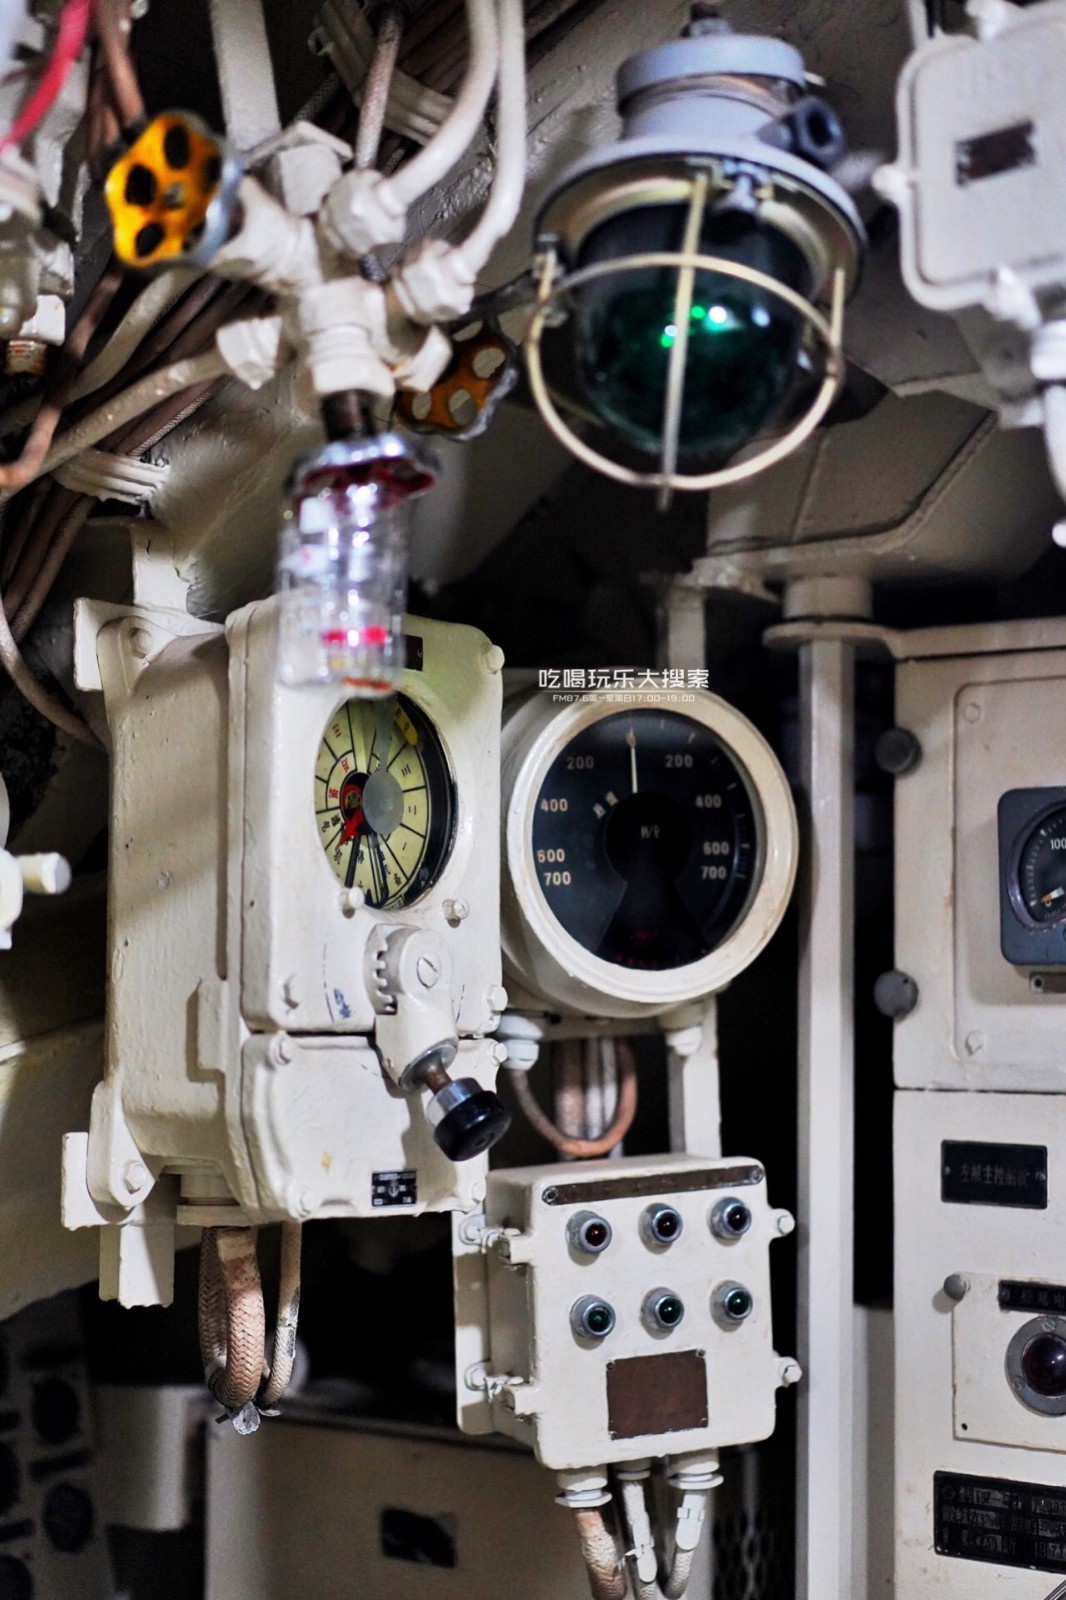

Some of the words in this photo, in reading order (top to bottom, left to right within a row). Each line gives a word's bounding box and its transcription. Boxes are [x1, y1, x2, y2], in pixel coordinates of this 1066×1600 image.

[566, 756, 594, 770] 200
[664, 754, 693, 768] 200
[540, 798, 568, 812] 400
[695, 794, 722, 808] 400
[703, 841, 730, 855] 600
[537, 849, 565, 863] 600
[544, 871, 571, 886] 700
[701, 866, 727, 880] 700
